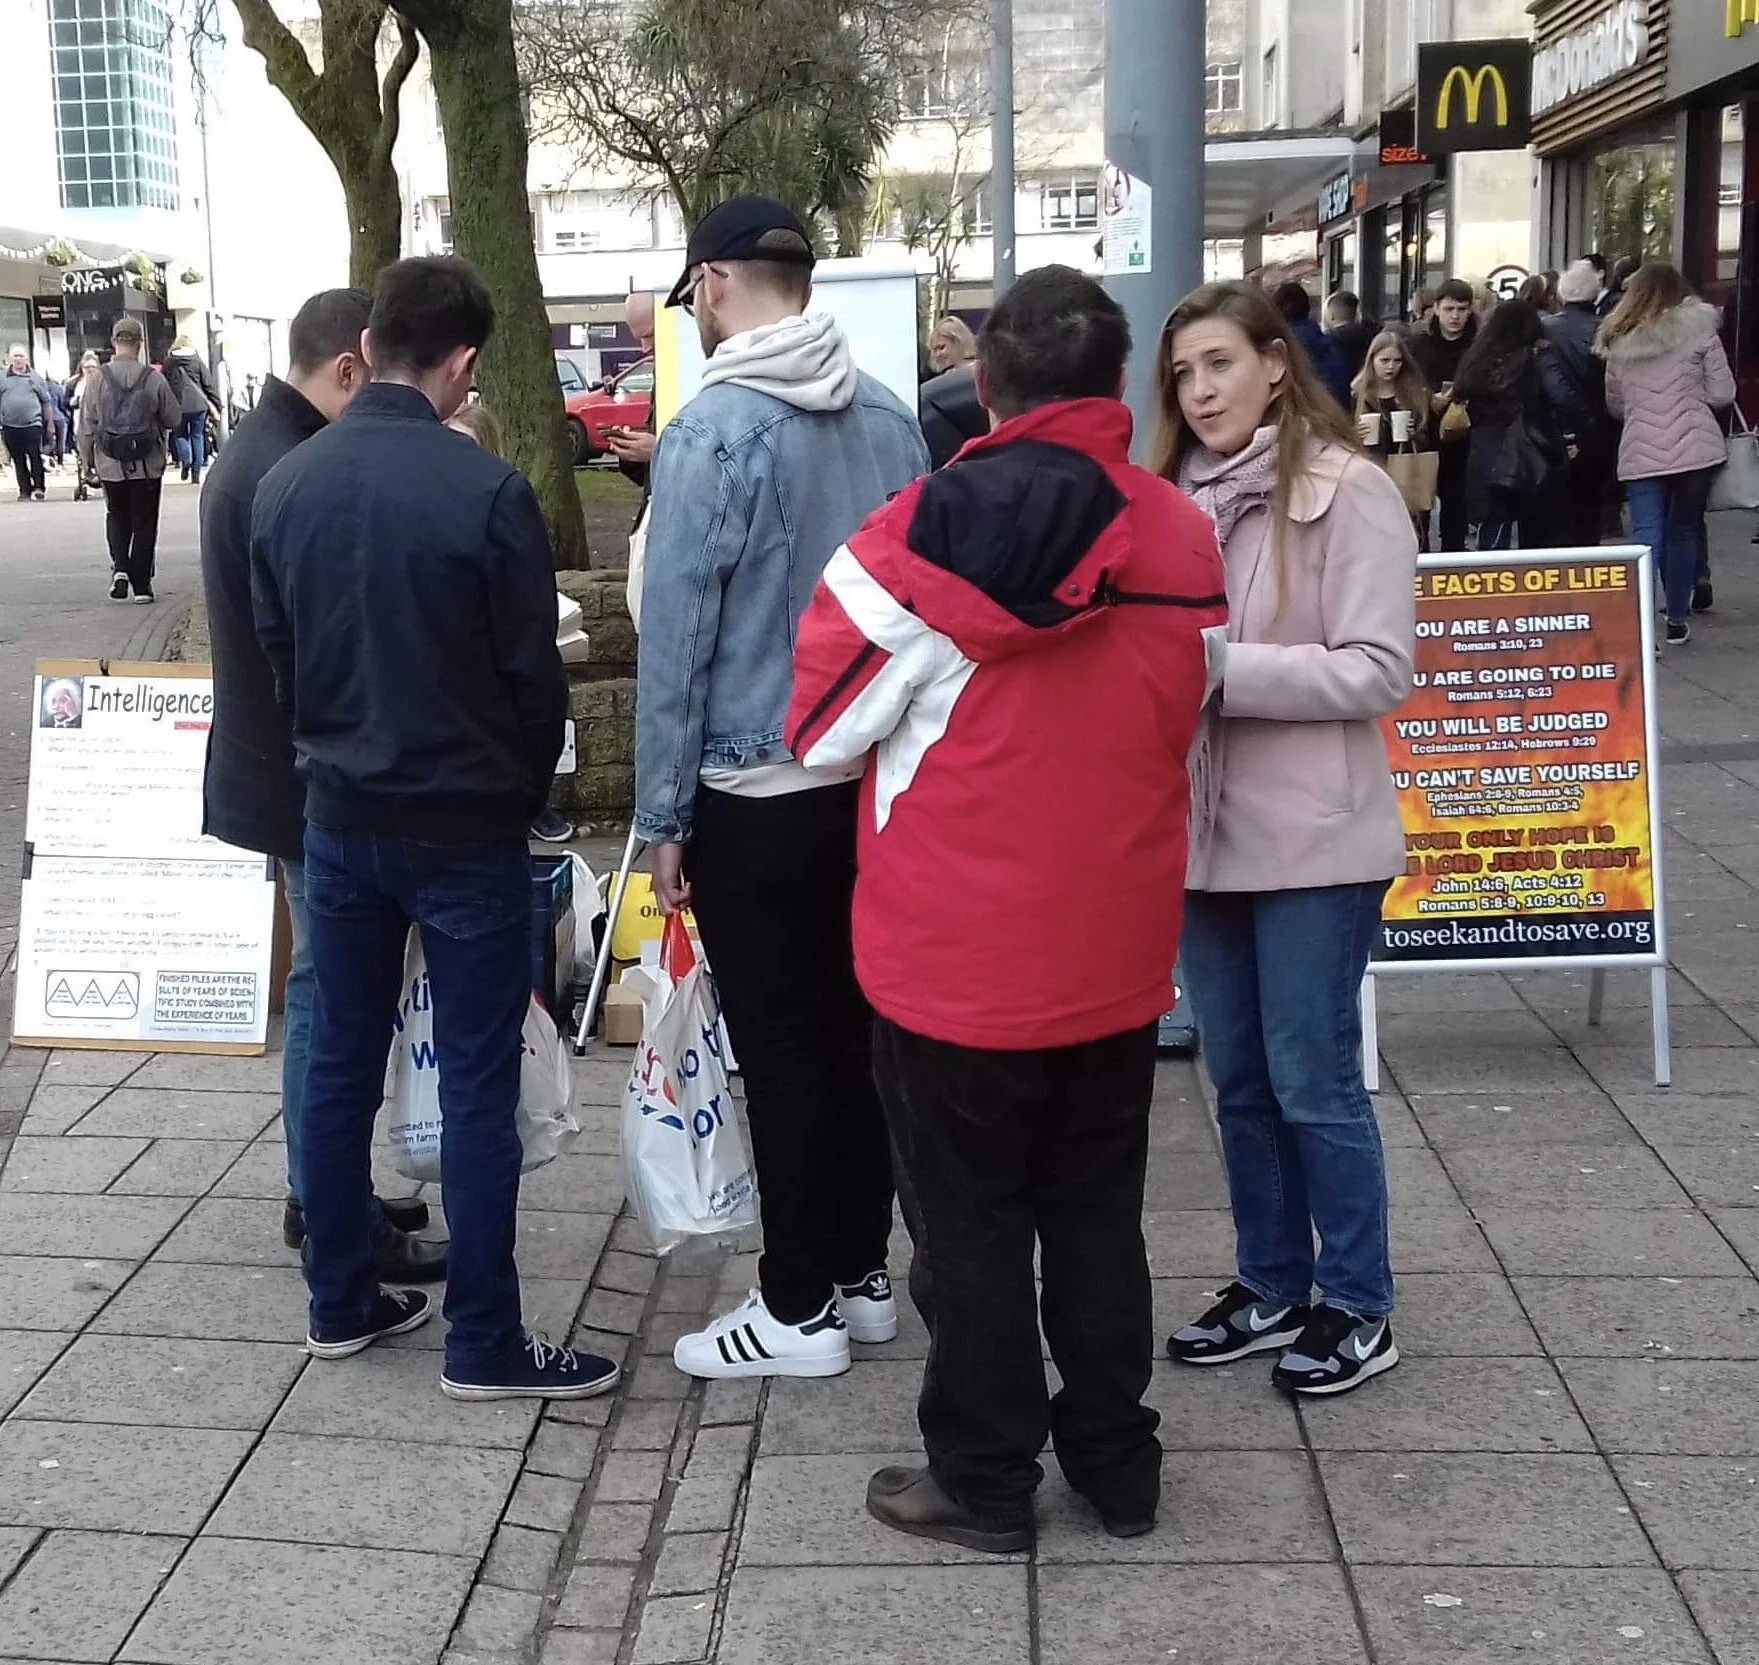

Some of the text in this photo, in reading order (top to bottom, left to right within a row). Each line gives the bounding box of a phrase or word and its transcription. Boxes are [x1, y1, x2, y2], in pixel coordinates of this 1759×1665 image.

[1381, 144, 1427, 163] size
[1432, 571, 1516, 596] FACTS
[1524, 569, 1560, 591] OF
[1569, 566, 1627, 588] LIFE
[1451, 620, 1490, 636] ARE
[1496, 618, 1510, 634] A
[1515, 615, 1591, 633] SINNER
[1454, 641, 1496, 652] Romans
[1529, 638, 1543, 649] 23
[1433, 671, 1473, 686] ARE
[1479, 668, 1544, 684] GOING
[1549, 666, 1576, 681] TO
[1582, 664, 1616, 680] DIE
[87, 684, 214, 722] Intelligence
[1448, 689, 1493, 701] Romans
[1396, 712, 1608, 738] YOU WILL BE JUDGED
[1416, 769, 1474, 788] CAN'T
[1480, 767, 1531, 785] SAVE
[1536, 762, 1640, 783] YOURSELF
[1518, 788, 1561, 799] Romans
[1498, 803, 1542, 814] Romans
[1404, 832, 1462, 851] YOUR
[1466, 829, 1524, 848] ONLY
[1530, 827, 1588, 846] HOPE
[1425, 853, 1483, 875] LORD
[1487, 850, 1556, 872] JESUS
[1561, 847, 1640, 870] CHRIST
[1432, 880, 1469, 893] John
[1513, 876, 1546, 890] Acts
[1550, 875, 1582, 888] 4:12
[1419, 899, 1476, 913] Romans
[1587, 892, 1605, 906] 13
[1383, 919, 1651, 949] toseekandtosave.org
